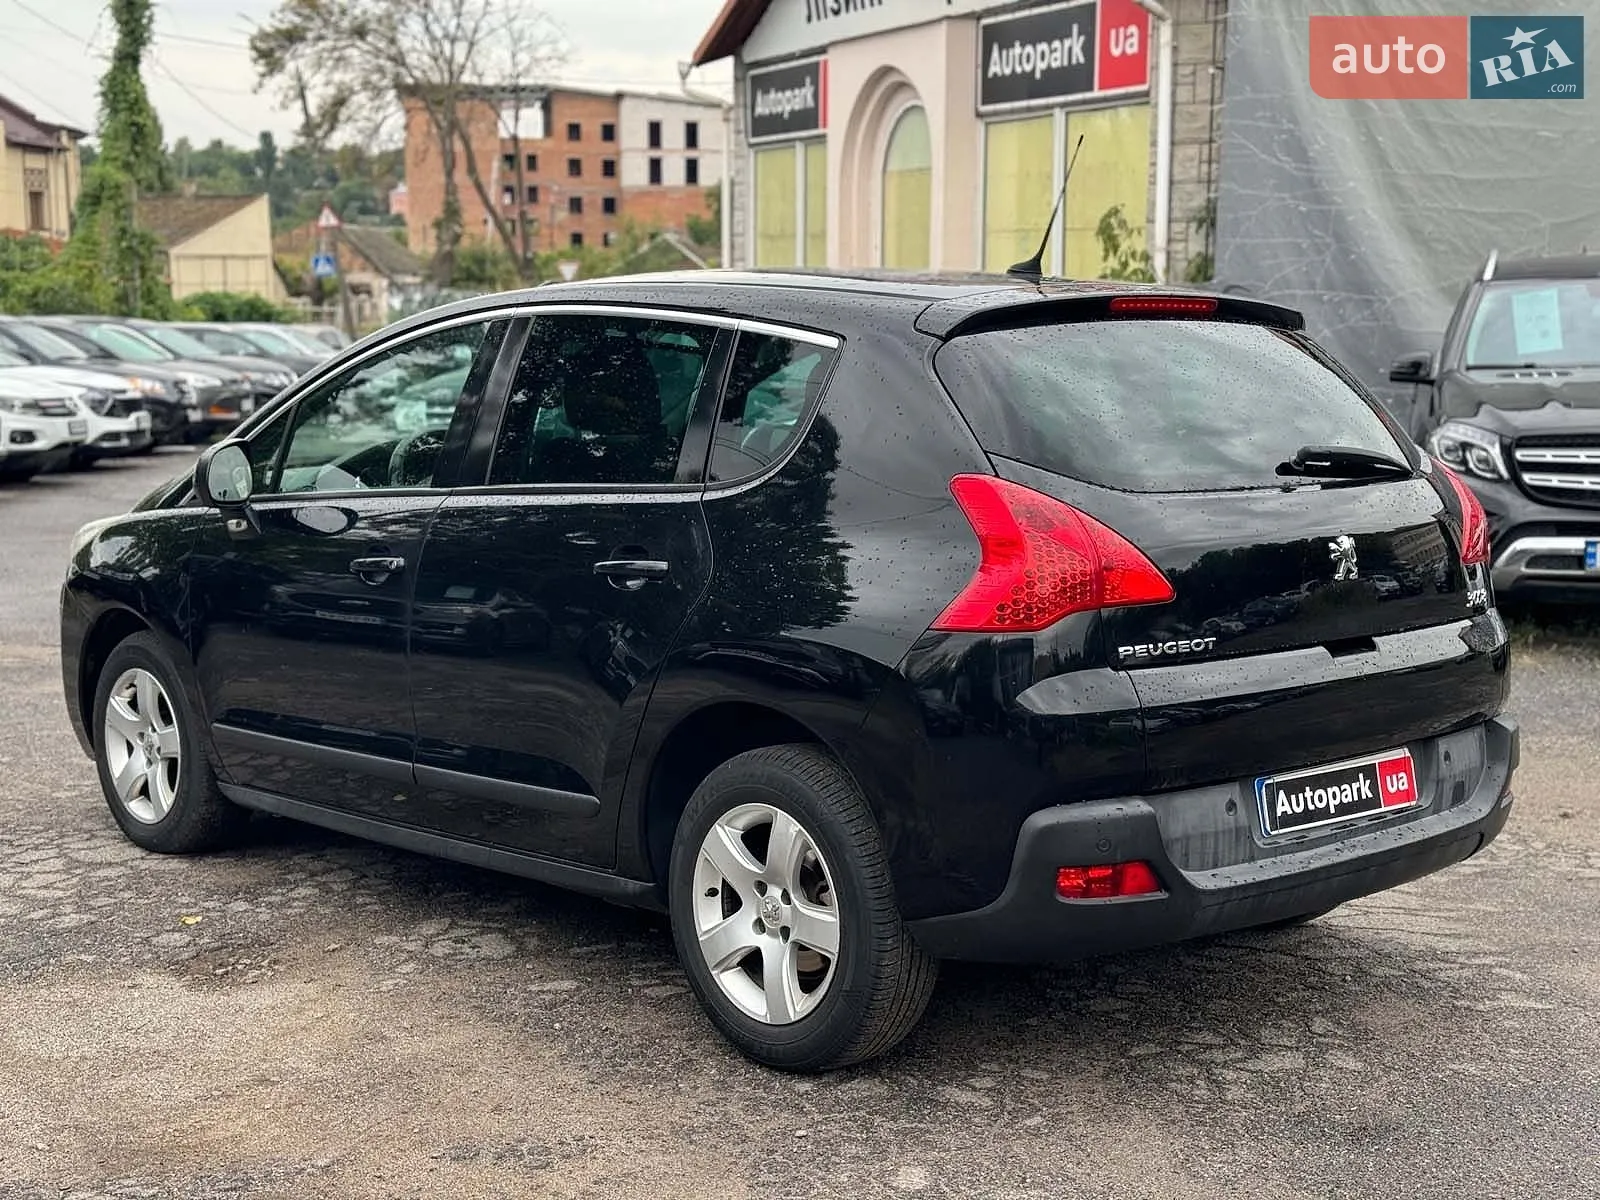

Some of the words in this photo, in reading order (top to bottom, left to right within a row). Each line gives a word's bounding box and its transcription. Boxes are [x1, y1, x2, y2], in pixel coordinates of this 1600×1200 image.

[988, 23, 1086, 80] Autopark
[1109, 24, 1140, 57] ua
[754, 75, 815, 120] Autopark
[1118, 636, 1217, 660] PEUGEOT
[1276, 772, 1374, 818] Autopark
[1386, 771, 1409, 794] ua
